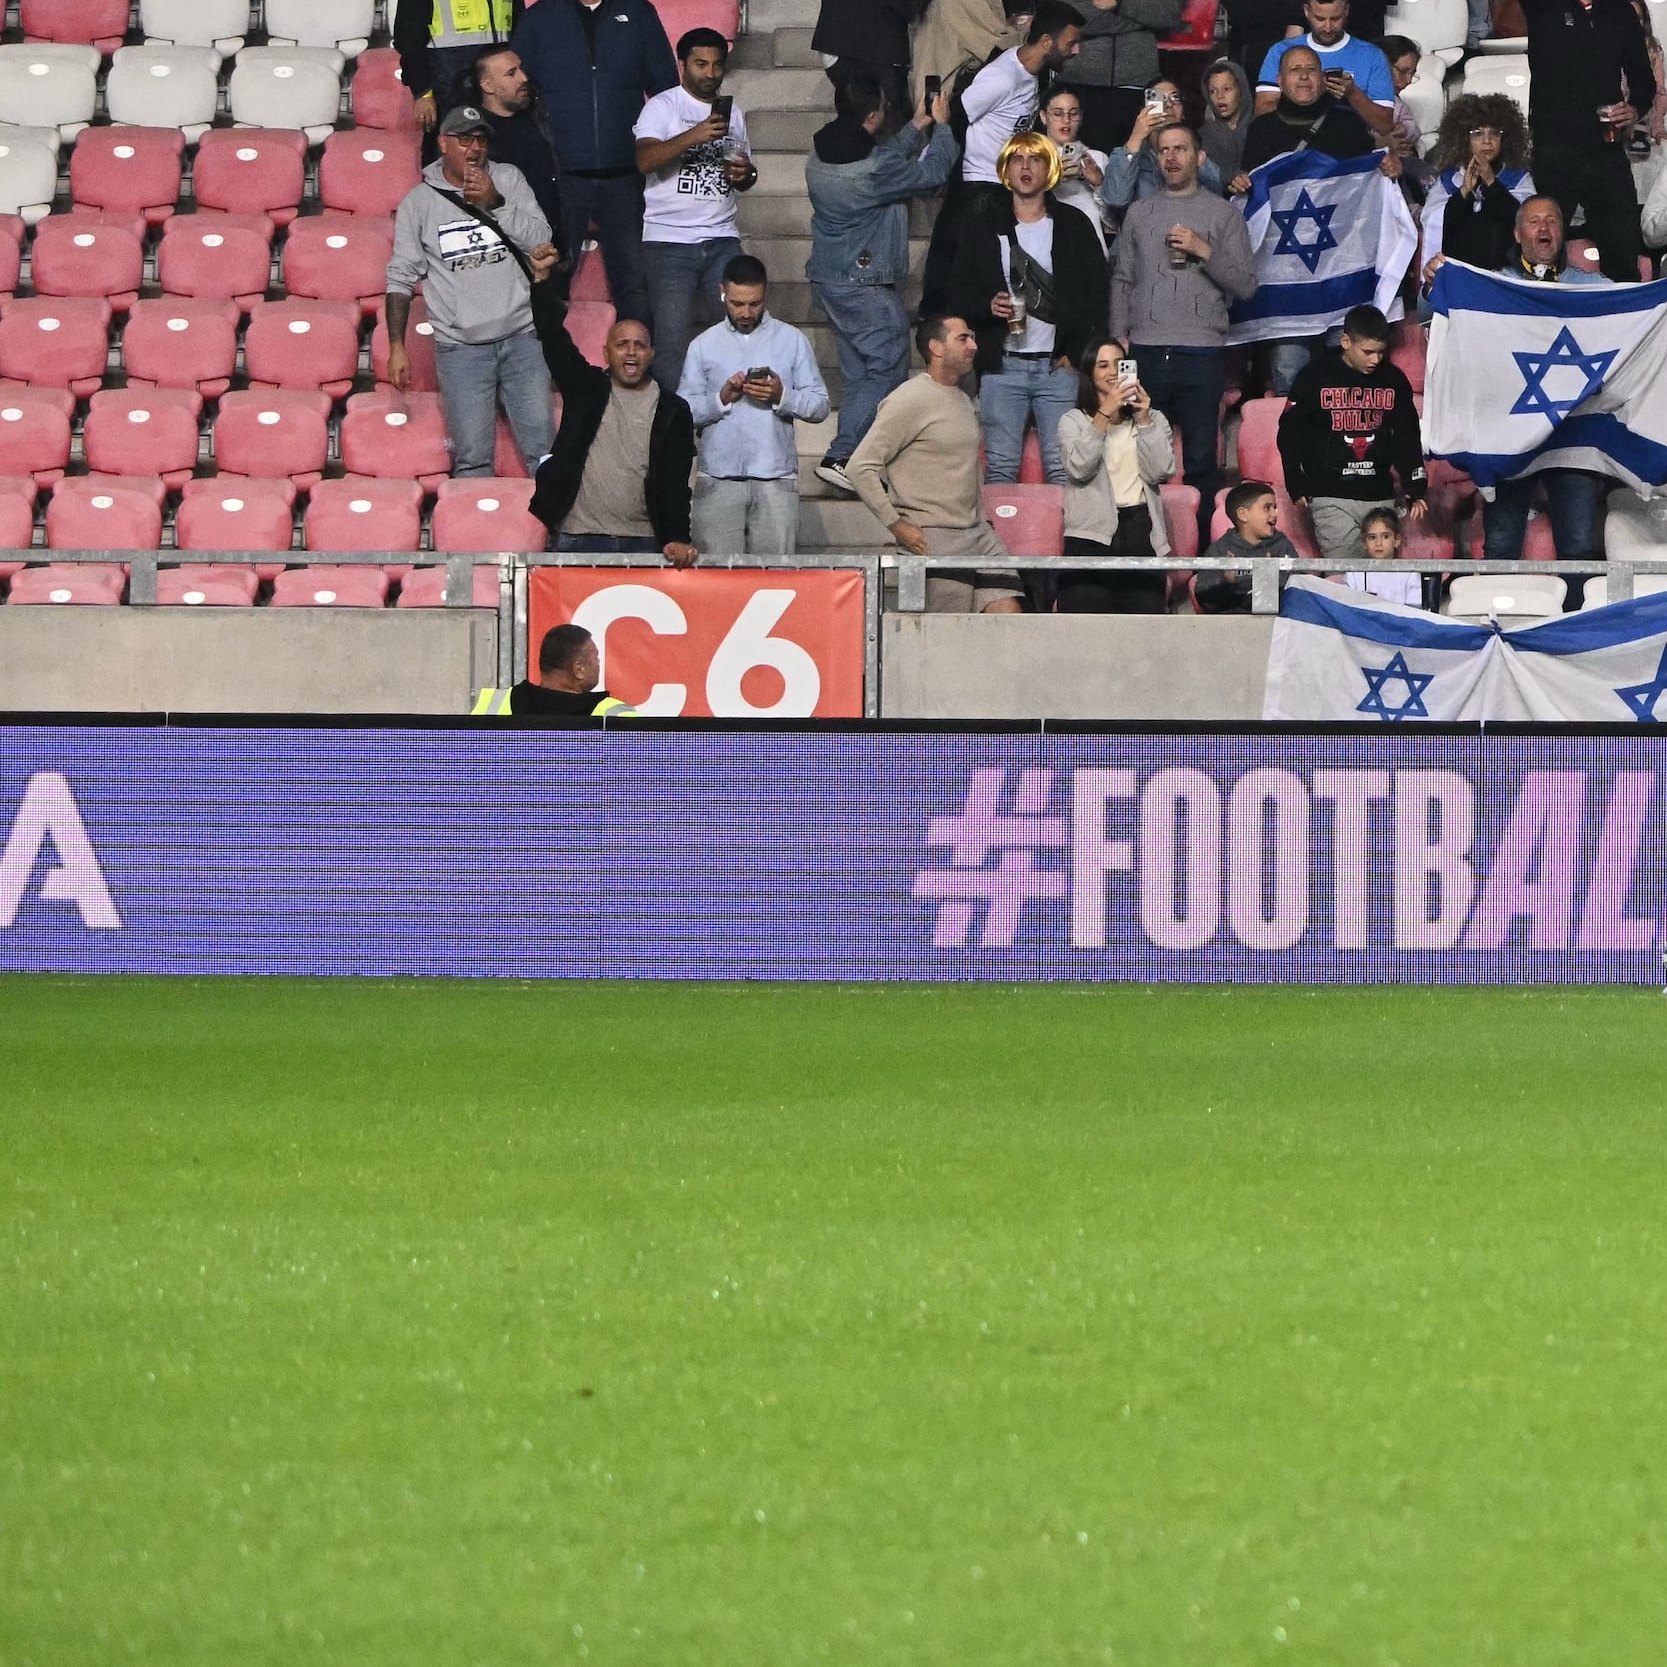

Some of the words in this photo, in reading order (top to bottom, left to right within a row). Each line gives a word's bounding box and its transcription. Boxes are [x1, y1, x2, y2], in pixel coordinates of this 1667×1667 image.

[1320, 386, 1396, 410] CHICAGO
[1332, 409, 1383, 432] BULLS
[571, 584, 822, 718] C6
[0, 772, 123, 929] A
